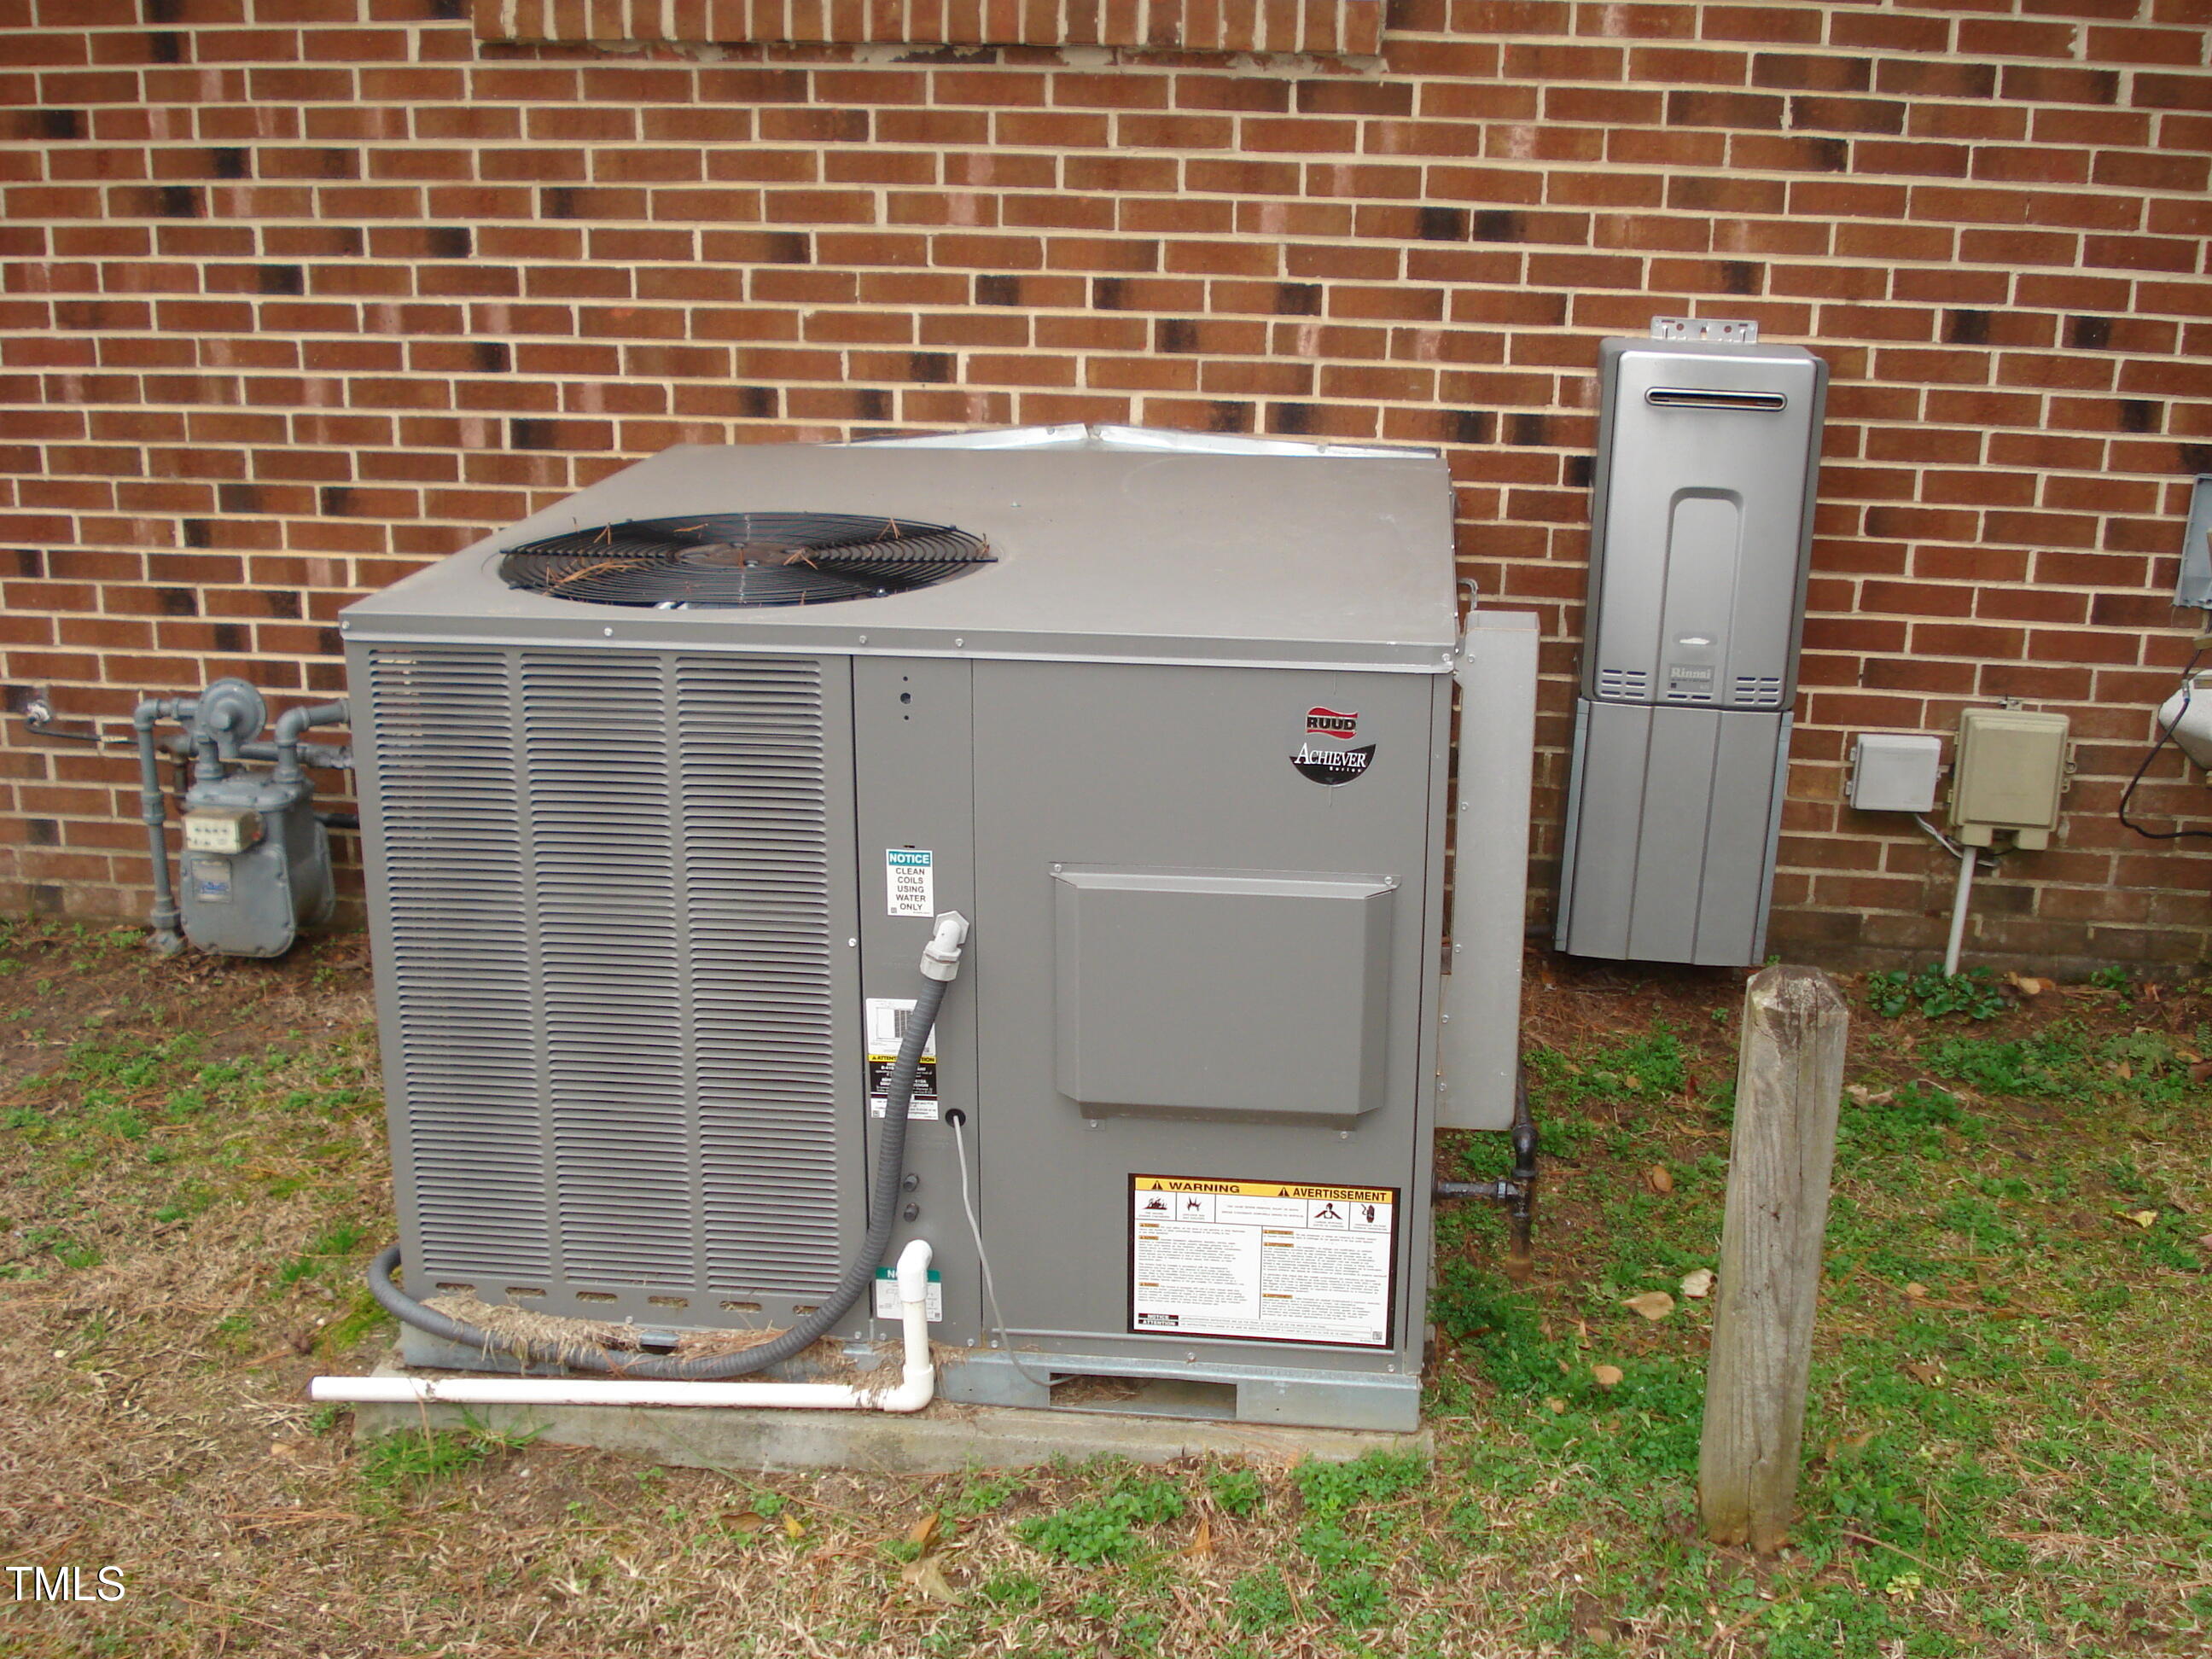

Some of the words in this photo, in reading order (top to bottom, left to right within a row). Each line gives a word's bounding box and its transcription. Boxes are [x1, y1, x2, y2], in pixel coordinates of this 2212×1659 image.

[1671, 667, 1711, 678] Rinnai
[1307, 717, 1356, 730] RUUD
[1294, 742, 1366, 767] ACHIEVER
[889, 853, 929, 864] NOTICE
[1169, 1182, 1240, 1193] WARNING
[1293, 1188, 1387, 1202] AVERTISSEMENT
